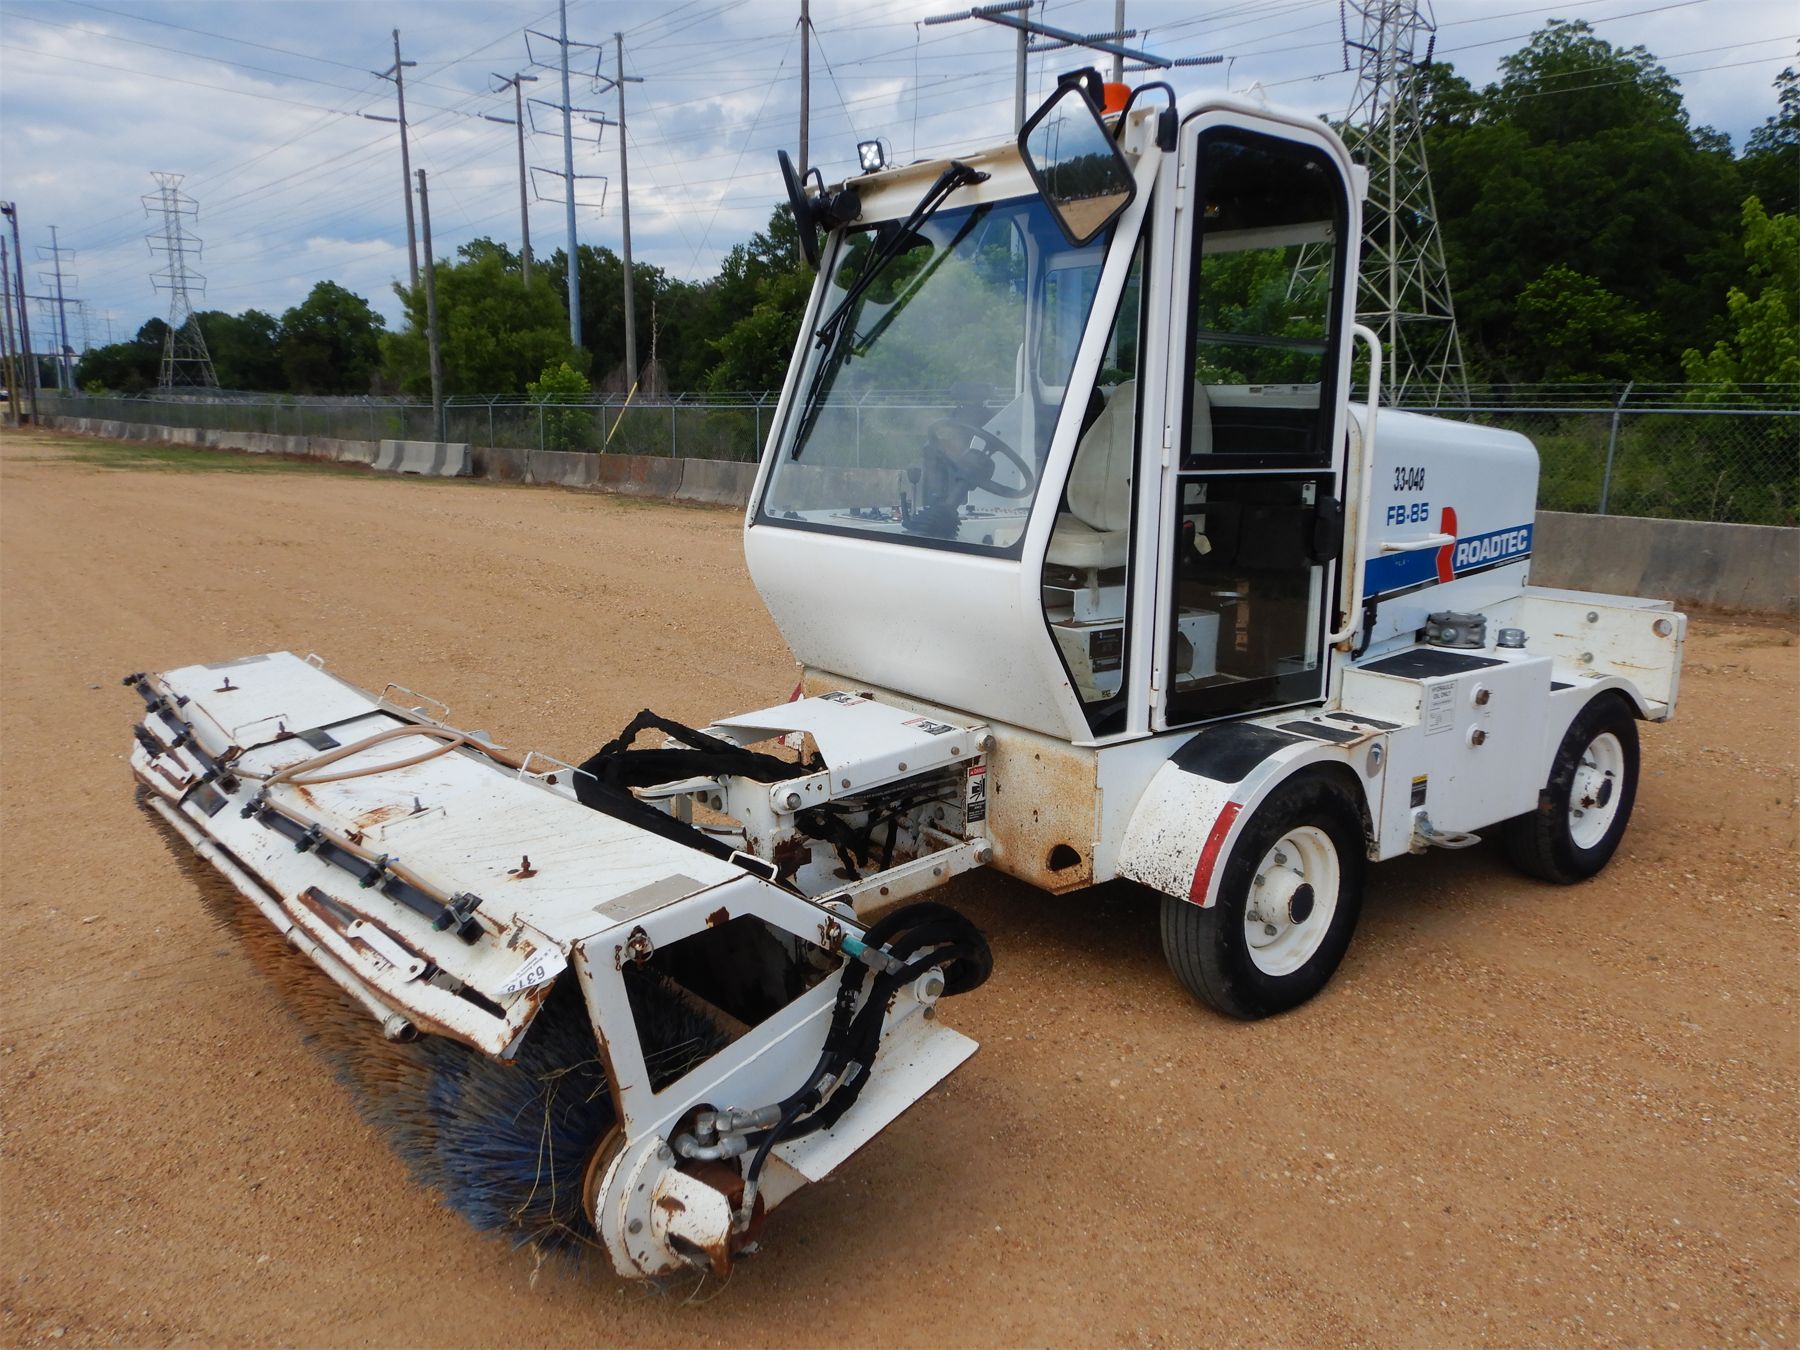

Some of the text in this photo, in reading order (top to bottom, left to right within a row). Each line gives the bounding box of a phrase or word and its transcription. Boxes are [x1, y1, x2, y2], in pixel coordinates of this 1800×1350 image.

[1394, 466, 1425, 491] 33-048
[1387, 502, 1429, 526] FB-85
[1456, 529, 1528, 567] ROADTEC
